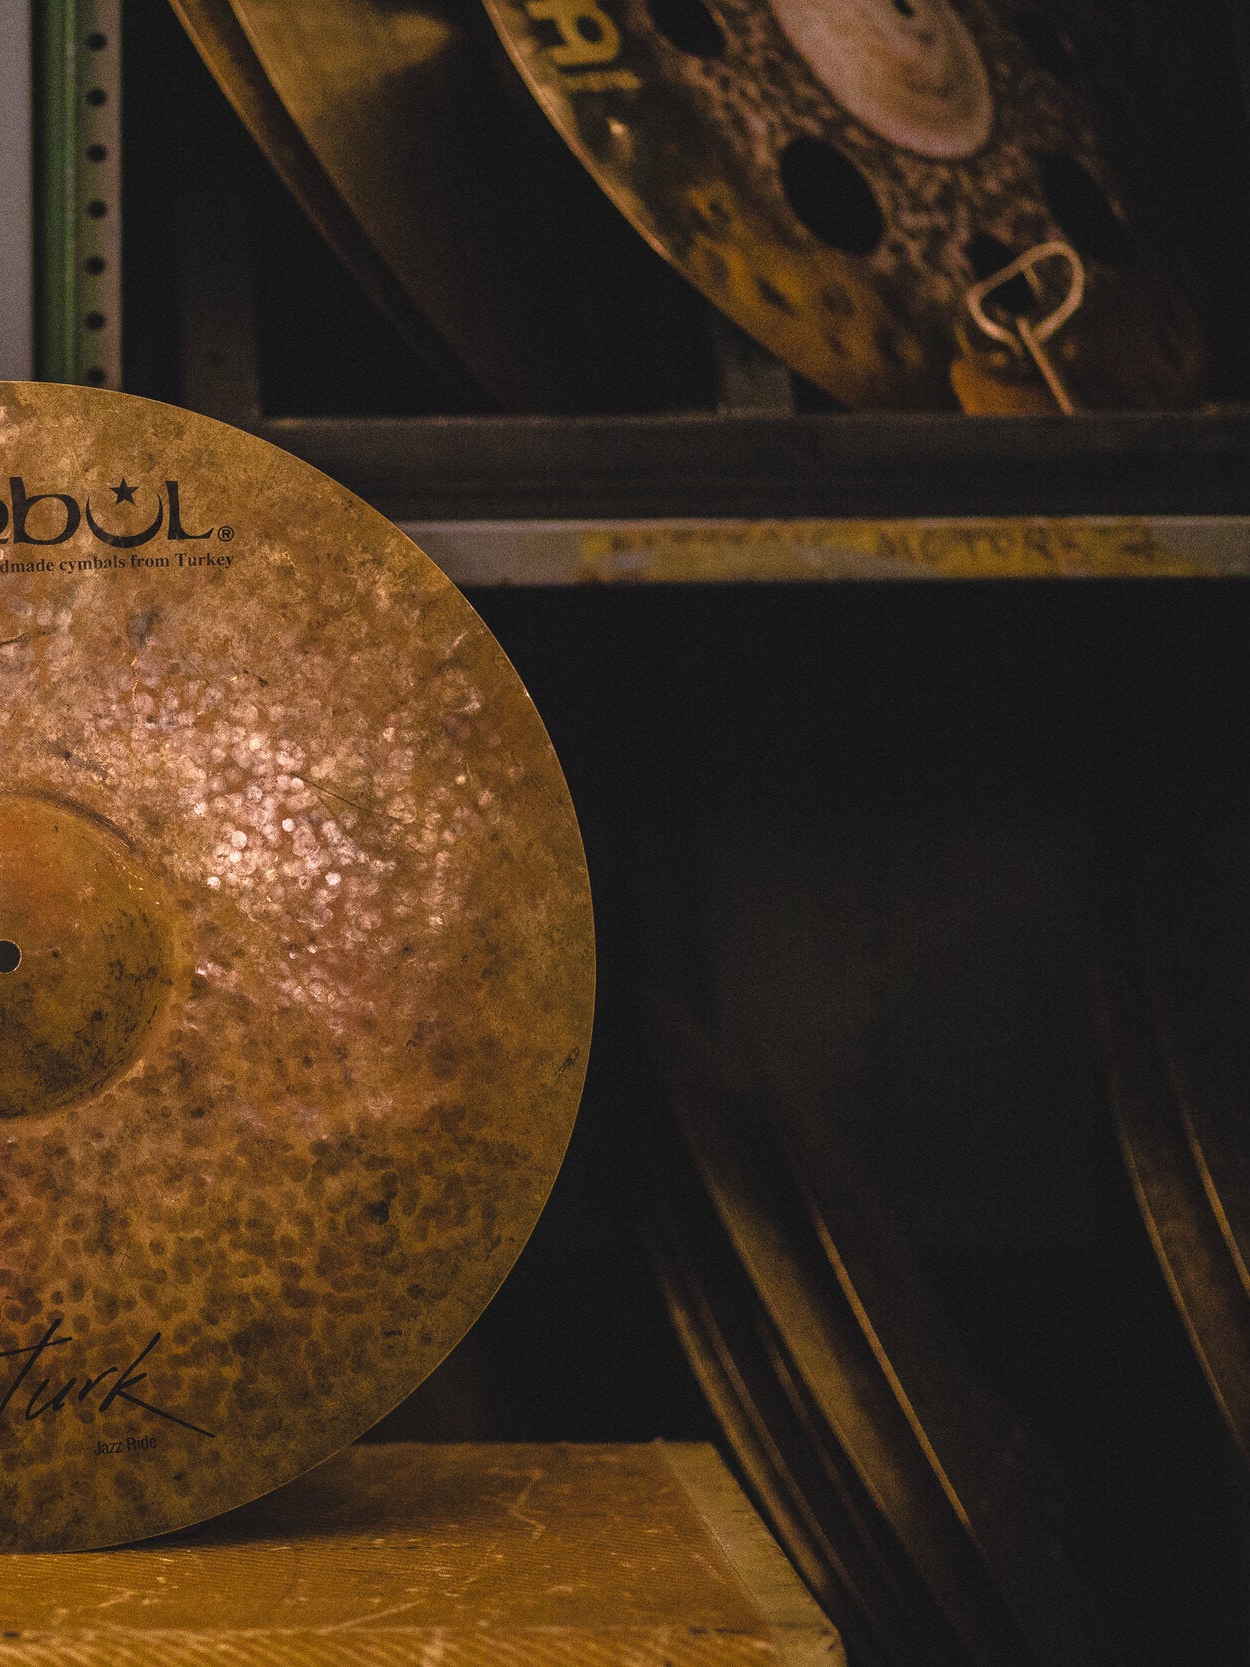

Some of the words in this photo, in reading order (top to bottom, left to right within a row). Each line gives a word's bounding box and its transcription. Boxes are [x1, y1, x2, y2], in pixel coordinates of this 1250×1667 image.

[59, 555, 126, 575] cymbals
[130, 554, 170, 569] from
[175, 552, 235, 569] Turkey
[93, 1440, 123, 1455] Jazz
[127, 1436, 158, 1452] Ride
